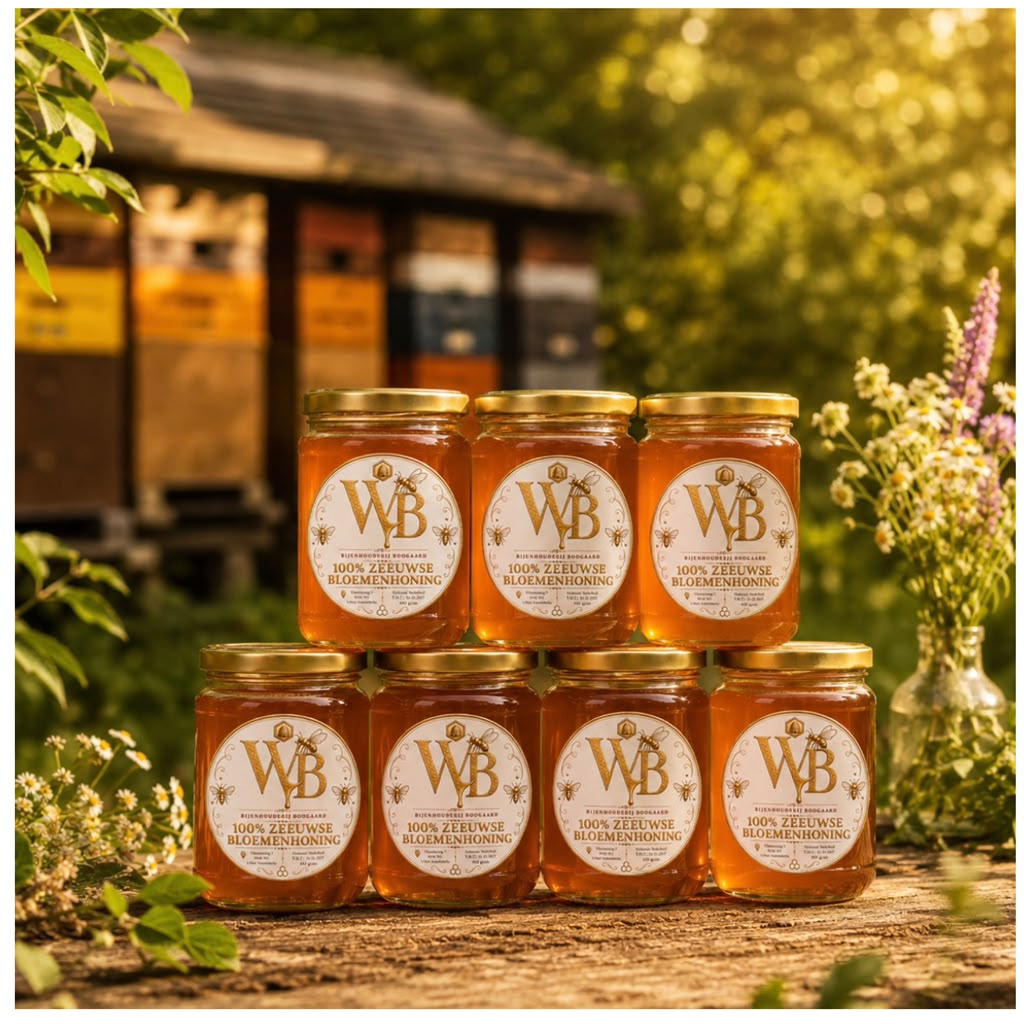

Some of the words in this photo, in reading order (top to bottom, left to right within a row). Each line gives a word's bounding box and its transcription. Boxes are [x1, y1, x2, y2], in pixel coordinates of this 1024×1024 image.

[340, 479, 428, 539] WB
[515, 481, 600, 539] WB
[683, 484, 767, 542] WB
[333, 563, 365, 573] 100%
[369, 563, 433, 573] ZEEUWSE
[508, 563, 540, 574] 100%
[544, 564, 606, 574] ZEEUWSE
[676, 565, 708, 575] 100%
[712, 565, 773, 575] ZEEUWSE
[328, 575, 442, 586] BLOEMENHONING
[503, 575, 614, 586] BLOEMENHONING
[672, 577, 780, 587] BLOEMENHONING
[240, 740, 328, 799] WB
[413, 740, 499, 798] WB
[585, 737, 669, 795] WB
[754, 736, 838, 794] WB
[408, 822, 438, 833] 100%
[442, 822, 505, 832] ZEEUWSE
[578, 819, 610, 830] 100%
[613, 819, 675, 829] ZEEUWSE
[747, 816, 777, 827] 100%
[782, 817, 843, 828] ZEEUWSE
[233, 823, 265, 834] 100%
[269, 823, 333, 834] ZEEUWSE
[742, 828, 851, 840] BLOEMENHONING
[227, 835, 341, 846] BLOEMENHONING
[402, 833, 513, 844] BLOEMENHONING
[574, 831, 682, 842] BLOEMENHONING
